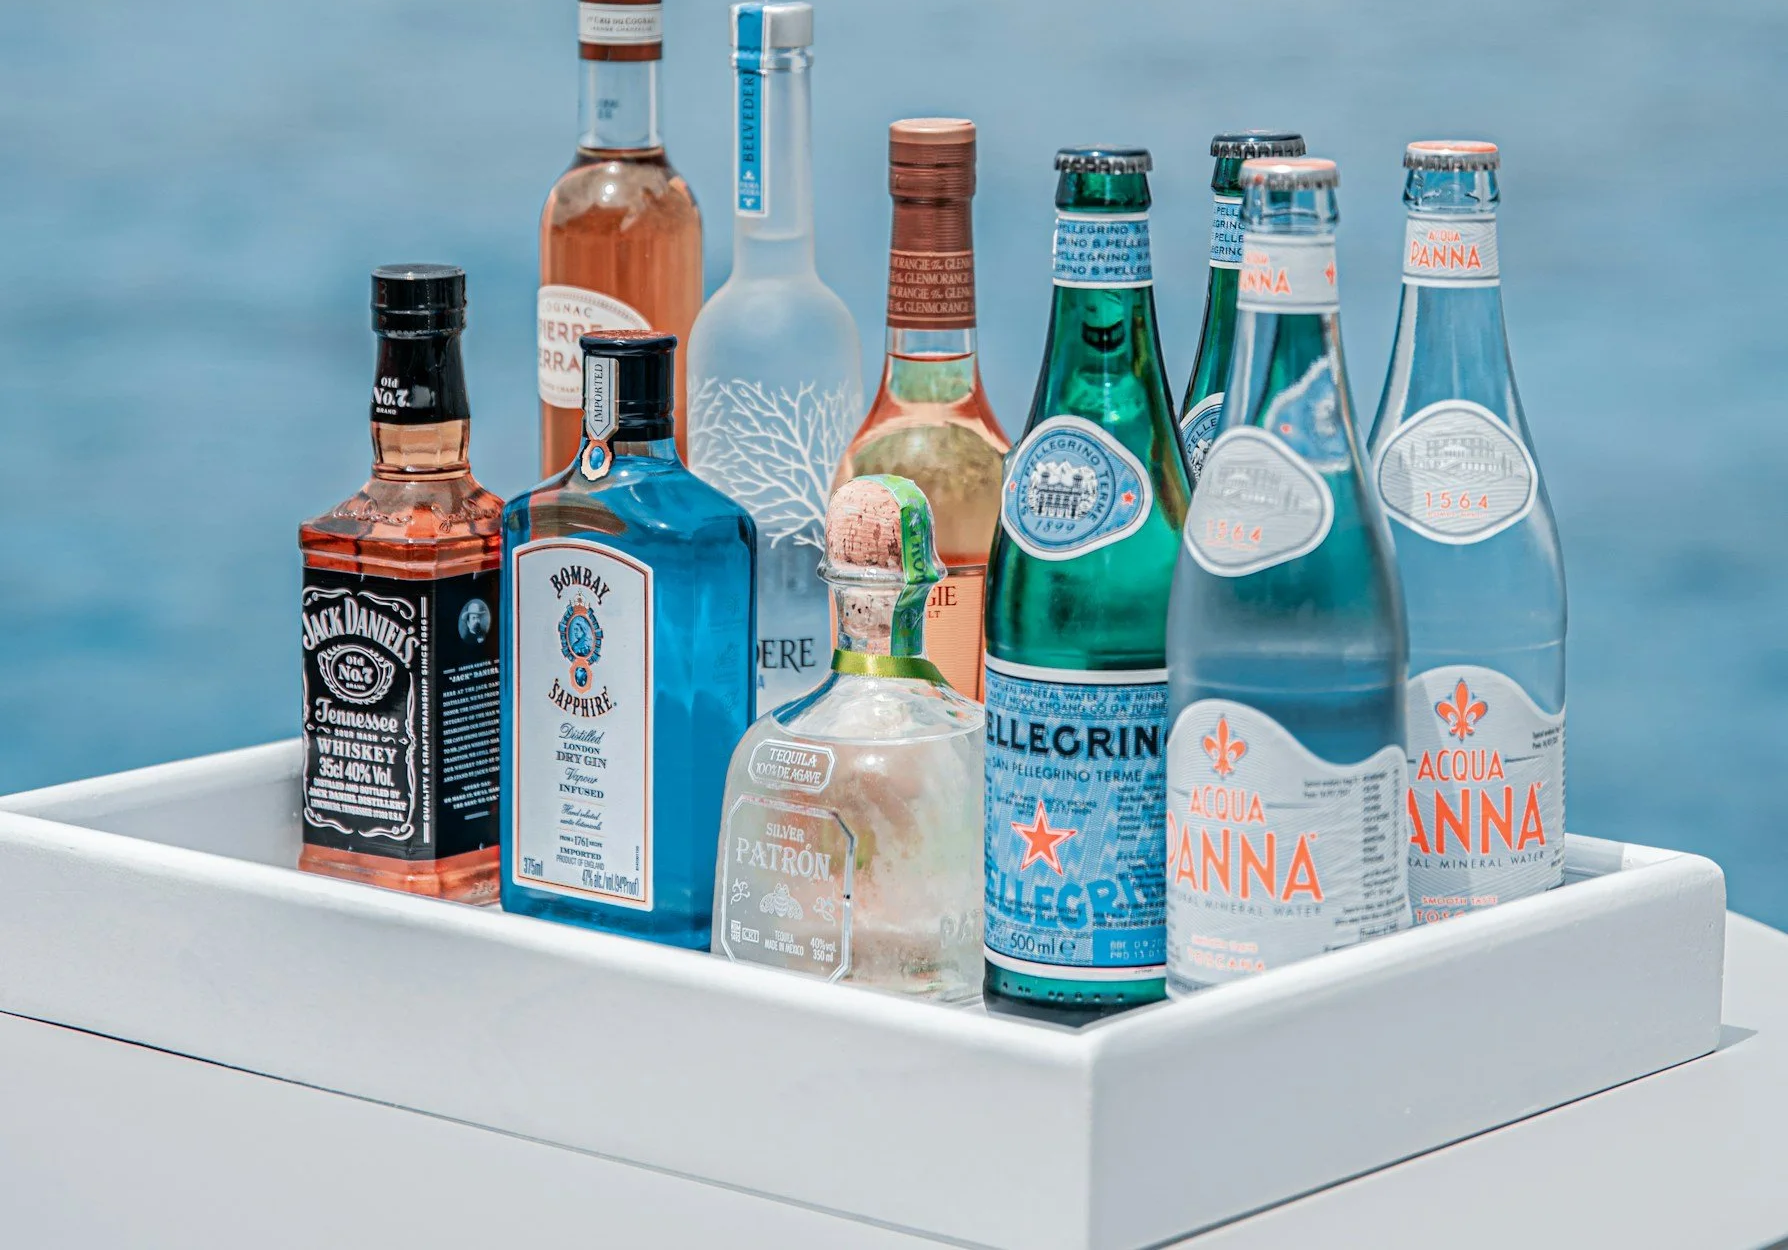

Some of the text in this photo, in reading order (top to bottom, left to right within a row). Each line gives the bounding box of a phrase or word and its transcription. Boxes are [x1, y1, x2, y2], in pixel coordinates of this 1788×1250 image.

[743, 70, 755, 163] BELVEDER
[1409, 240, 1482, 270] PANNA
[380, 377, 399, 388] Old
[594, 363, 603, 423] IMPORTED
[376, 407, 397, 415] BRAND
[1025, 438, 1101, 478] PELLEGRINO
[1088, 469, 1110, 523] TERME
[1424, 490, 1489, 510] 1564
[1205, 517, 1264, 544] 1564
[550, 565, 611, 605] BOMBAY
[302, 597, 421, 670] JACK DANIEL'S
[345, 654, 366, 667] Old
[420, 644, 429, 676] SINCE
[338, 664, 374, 685] No.7
[548, 677, 613, 718] SAPPHIRE
[315, 696, 400, 734] Tennessee
[420, 678, 430, 766] CRAFTSMANSHIP
[333, 728, 379, 743] SOUR MASH
[559, 722, 605, 745] Distilled
[986, 710, 1168, 760] ELLEGRIN
[315, 737, 398, 765] WHISKEY
[563, 742, 601, 755] LONDON
[770, 747, 818, 768] TEQUILA
[555, 750, 608, 770] DRY GIN
[1417, 749, 1506, 782] ACQUA
[319, 756, 396, 788] 35cl 40% Vol.
[422, 767, 431, 775] &
[564, 767, 599, 786] Vapour
[756, 761, 822, 785] 100% DE AGAVE
[1012, 762, 1091, 783] PELLEGRINO
[1096, 769, 1142, 783] TERME
[308, 786, 329, 799] JACK
[357, 794, 408, 811] DISTILLERY
[422, 776, 431, 821] QUALITY
[559, 783, 605, 799] INFUSED
[1189, 784, 1267, 826] ACQUA
[574, 835, 589, 848] 1761
[766, 822, 805, 843] SILVER
[556, 854, 605, 871] PRODUCT OF ENGLAND
[560, 846, 602, 860] IMPORTED
[1439, 857, 1504, 870] MINERAL
[1510, 851, 1545, 865] WATER
[523, 857, 543, 877] 375ml
[1203, 898, 1265, 918] MINERAL
[1273, 904, 1323, 919] WATER
[764, 938, 779, 951] MADE
[778, 941, 785, 952] IN
[810, 937, 826, 950] 40%
[1011, 932, 1035, 952] 500
[1037, 937, 1055, 954] ml
[812, 948, 834, 963] 350 ml
[1187, 945, 1266, 972] TOSCANA
